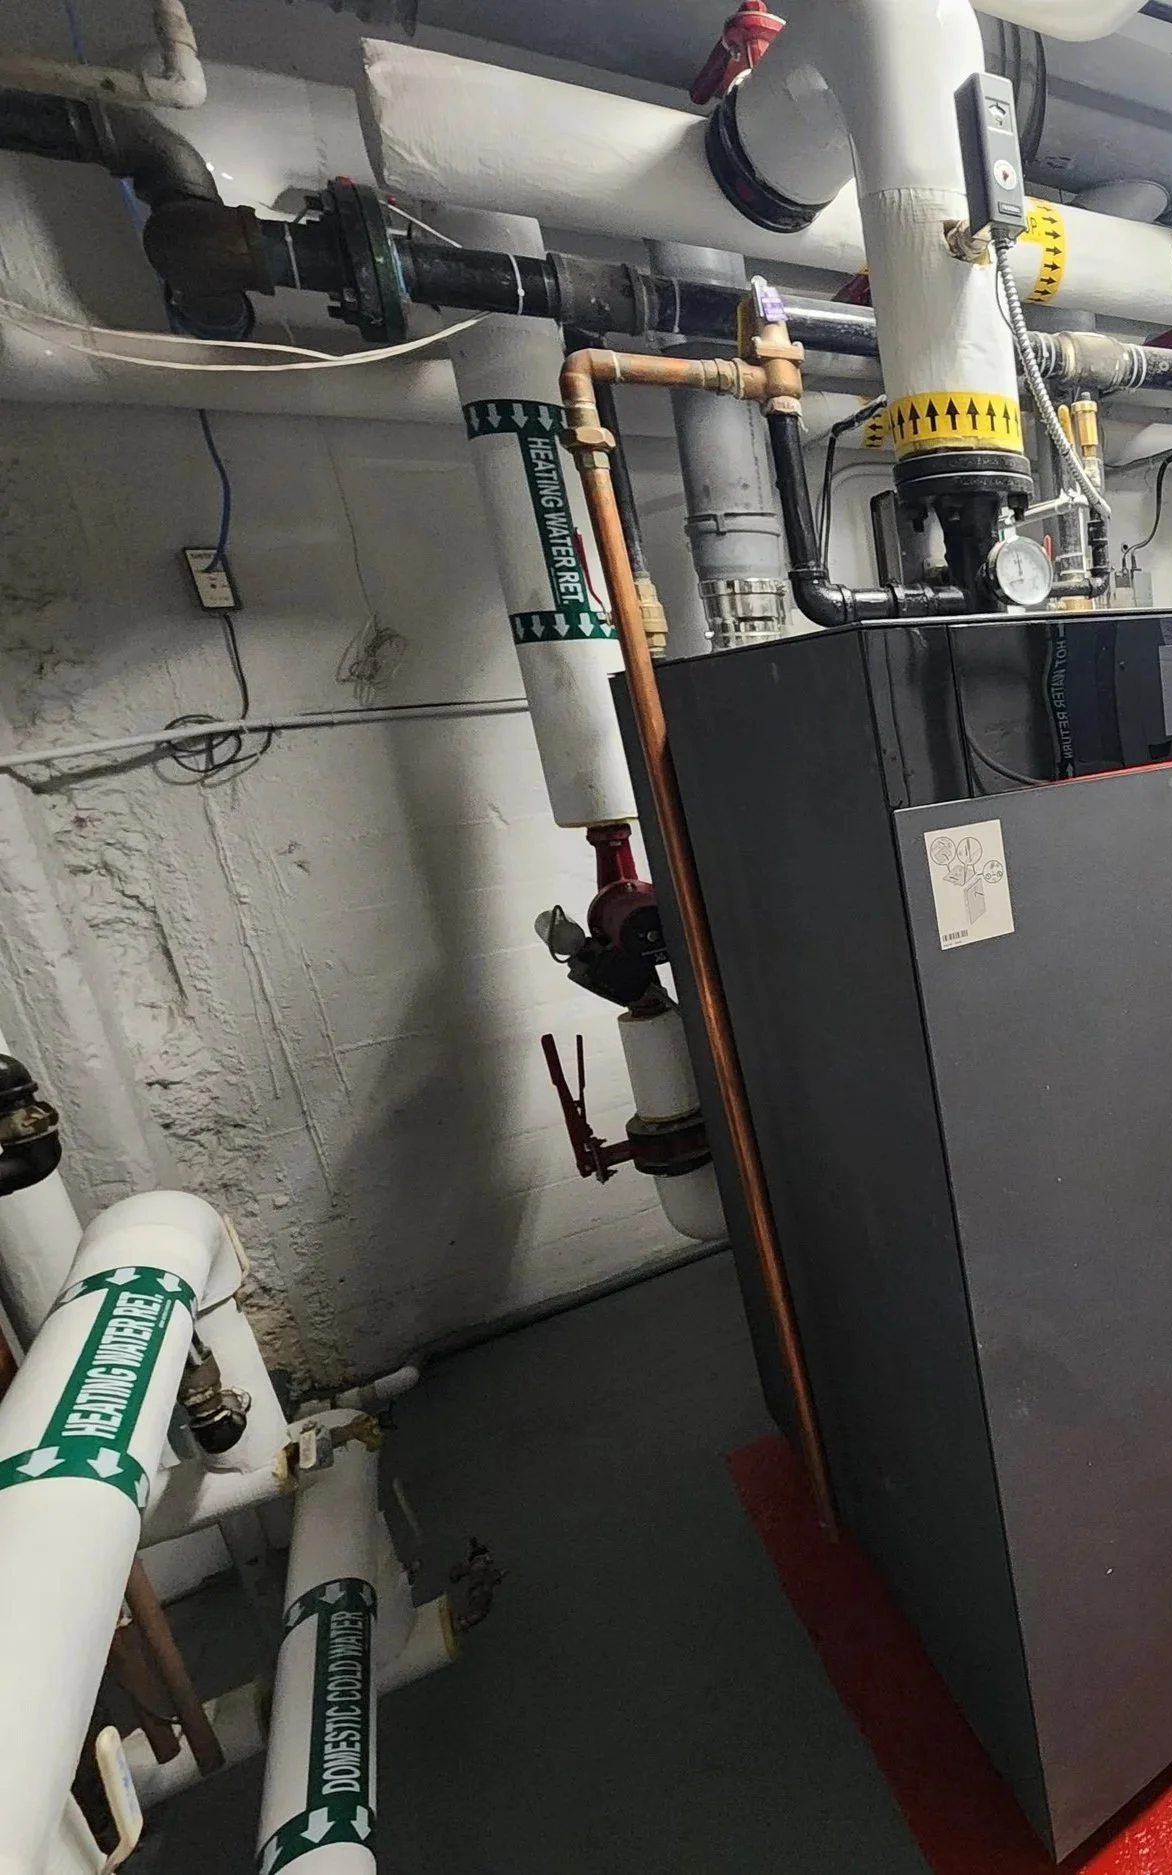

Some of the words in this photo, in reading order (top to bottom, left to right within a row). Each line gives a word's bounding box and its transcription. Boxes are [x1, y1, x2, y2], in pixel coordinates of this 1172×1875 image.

[528, 437, 563, 507] HEATING
[544, 511, 575, 569] WATER
[557, 571, 584, 604] RET.
[113, 1291, 164, 1320] RET.
[92, 1318, 155, 1367] WATER
[62, 1368, 137, 1439] HEATING
[328, 1611, 363, 1659] WATER
[327, 1660, 362, 1701] COLD
[322, 1706, 362, 1795] DOMESTIC
